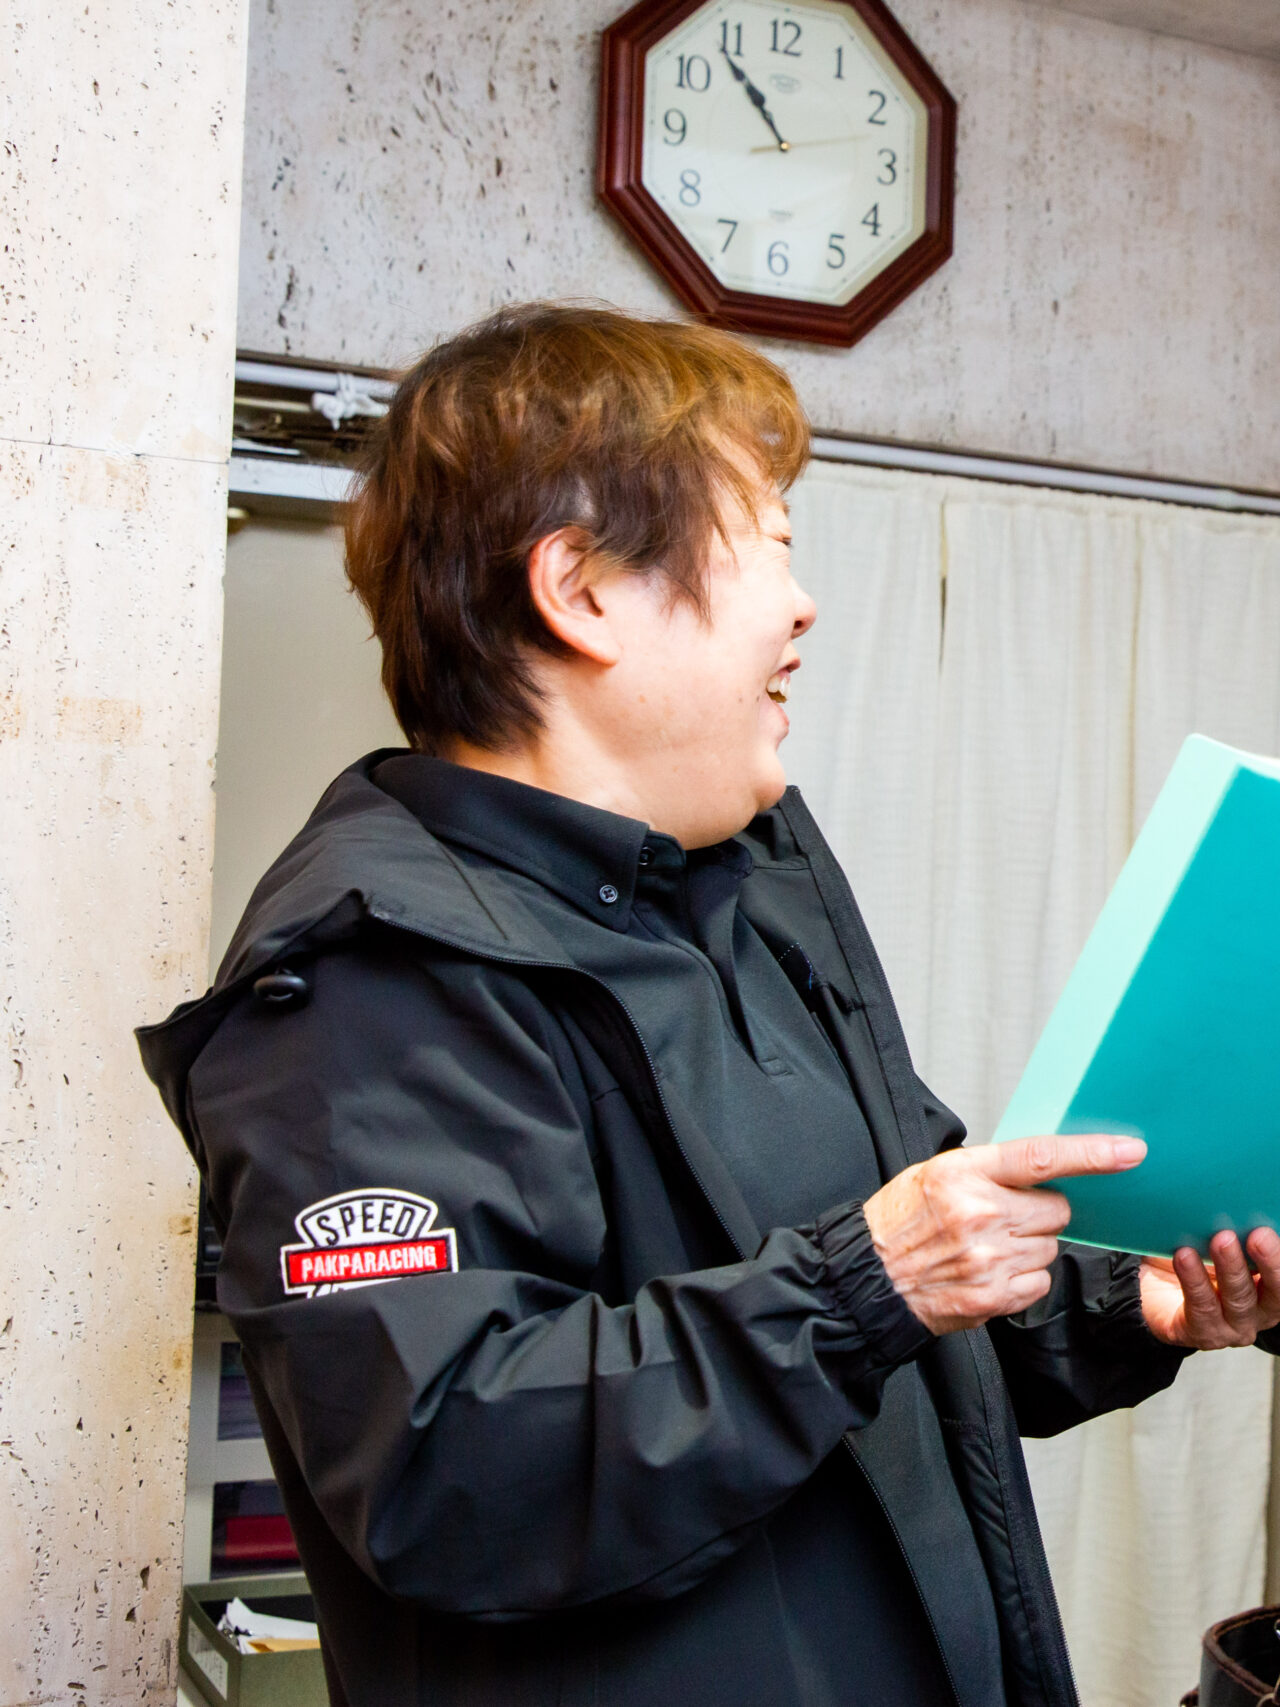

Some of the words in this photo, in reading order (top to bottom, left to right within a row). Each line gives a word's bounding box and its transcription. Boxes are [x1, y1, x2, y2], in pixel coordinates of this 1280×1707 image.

[720, 19, 744, 57] 11
[770, 18, 802, 57] 12
[676, 54, 711, 92] 10
[834, 46, 846, 79] 1
[867, 90, 888, 125] 2
[663, 108, 687, 146] 9
[876, 149, 898, 185] 3
[679, 169, 701, 207] 8
[717, 218, 739, 253] 7
[861, 202, 883, 236] 4
[767, 241, 789, 277] 6
[826, 234, 846, 269] 5
[316, 1201, 416, 1246] SPEED
[302, 1246, 437, 1281] PAKPARACING
